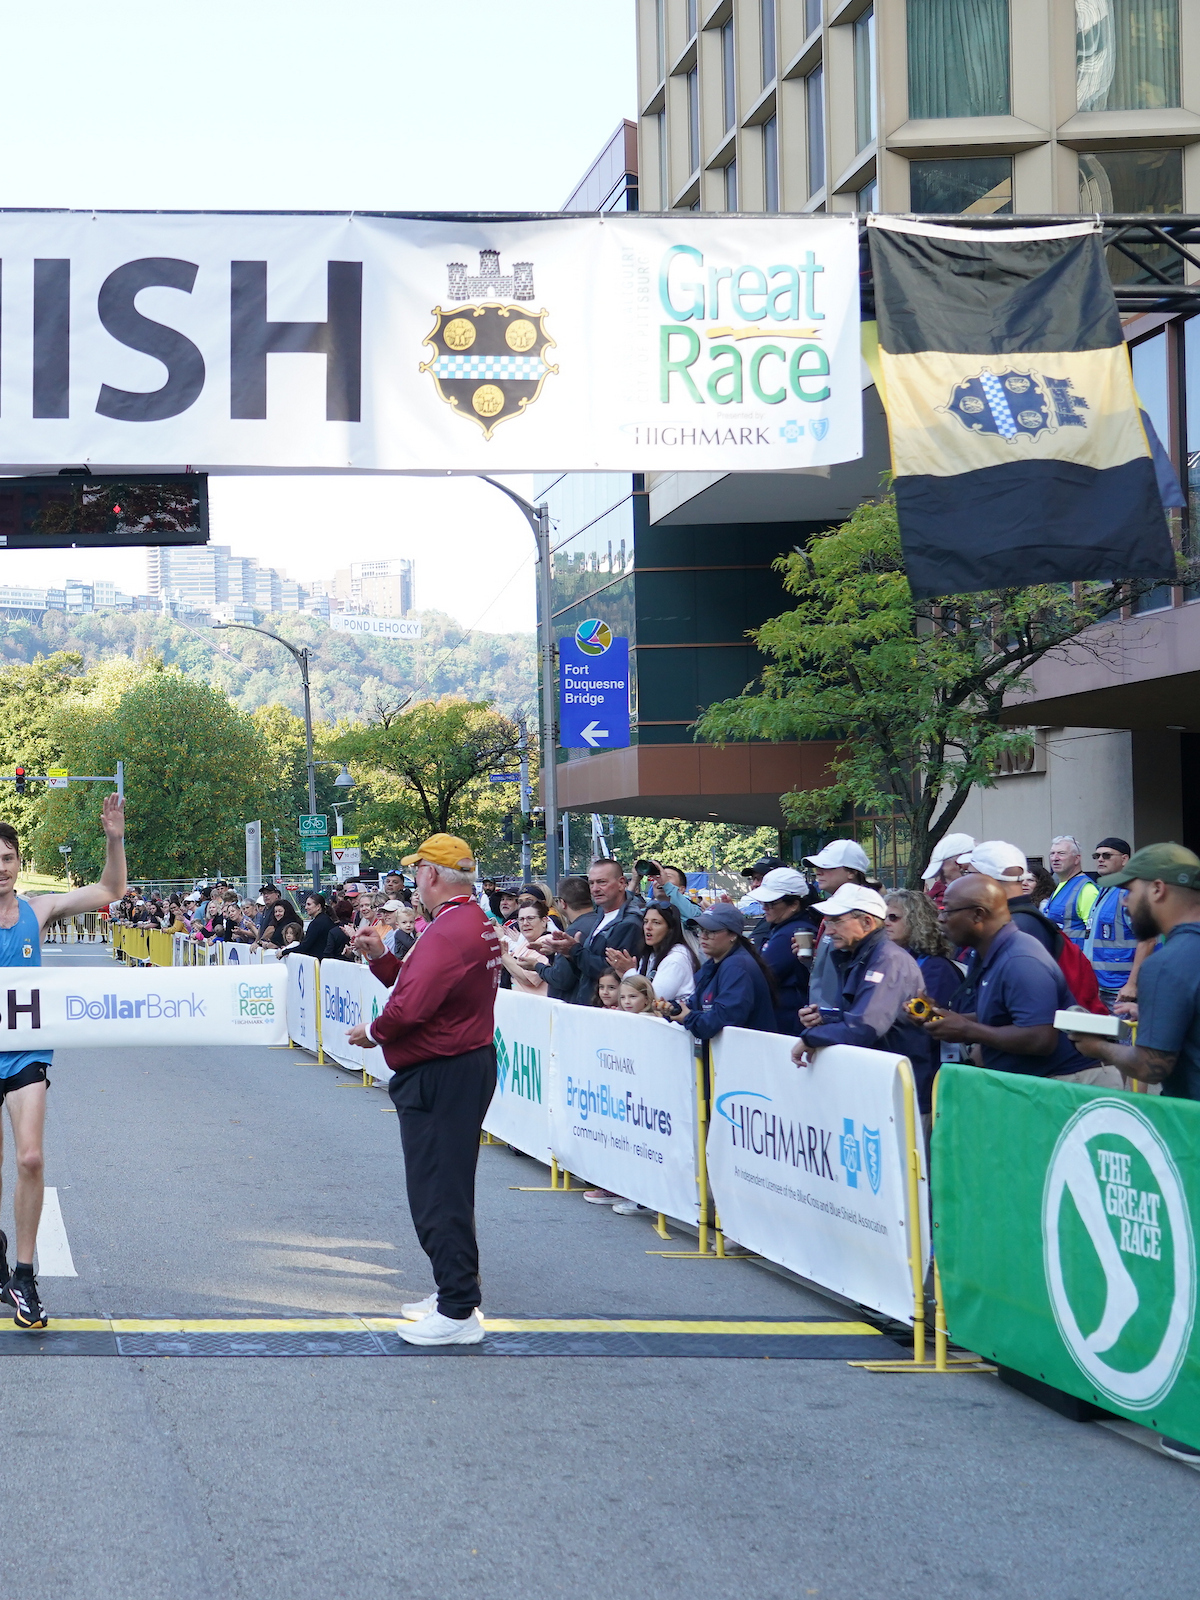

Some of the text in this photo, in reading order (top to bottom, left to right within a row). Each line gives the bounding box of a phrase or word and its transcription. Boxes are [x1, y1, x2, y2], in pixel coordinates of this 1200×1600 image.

[658, 243, 826, 322] Great
[659, 325, 831, 405] Race
[634, 426, 771, 446] HIGHMARK
[344, 619, 419, 635] POND LEHOCKY
[564, 664, 589, 675] Fort
[564, 679, 625, 691] Duquesne
[564, 693, 605, 706] Bridge
[65, 991, 203, 1021] DollarBank
[238, 982, 274, 999] Great
[239, 998, 275, 1016] Race
[510, 1040, 542, 1105] AHN
[600, 1051, 636, 1077] HIGHMARK
[566, 1075, 672, 1137] BrightBlueFutures
[572, 1124, 664, 1165] community health resilience
[730, 1101, 835, 1182] HIGHMARK
[1097, 1148, 1132, 1183] THE
[1105, 1182, 1161, 1229] GREAT
[1120, 1224, 1162, 1262] RACE
